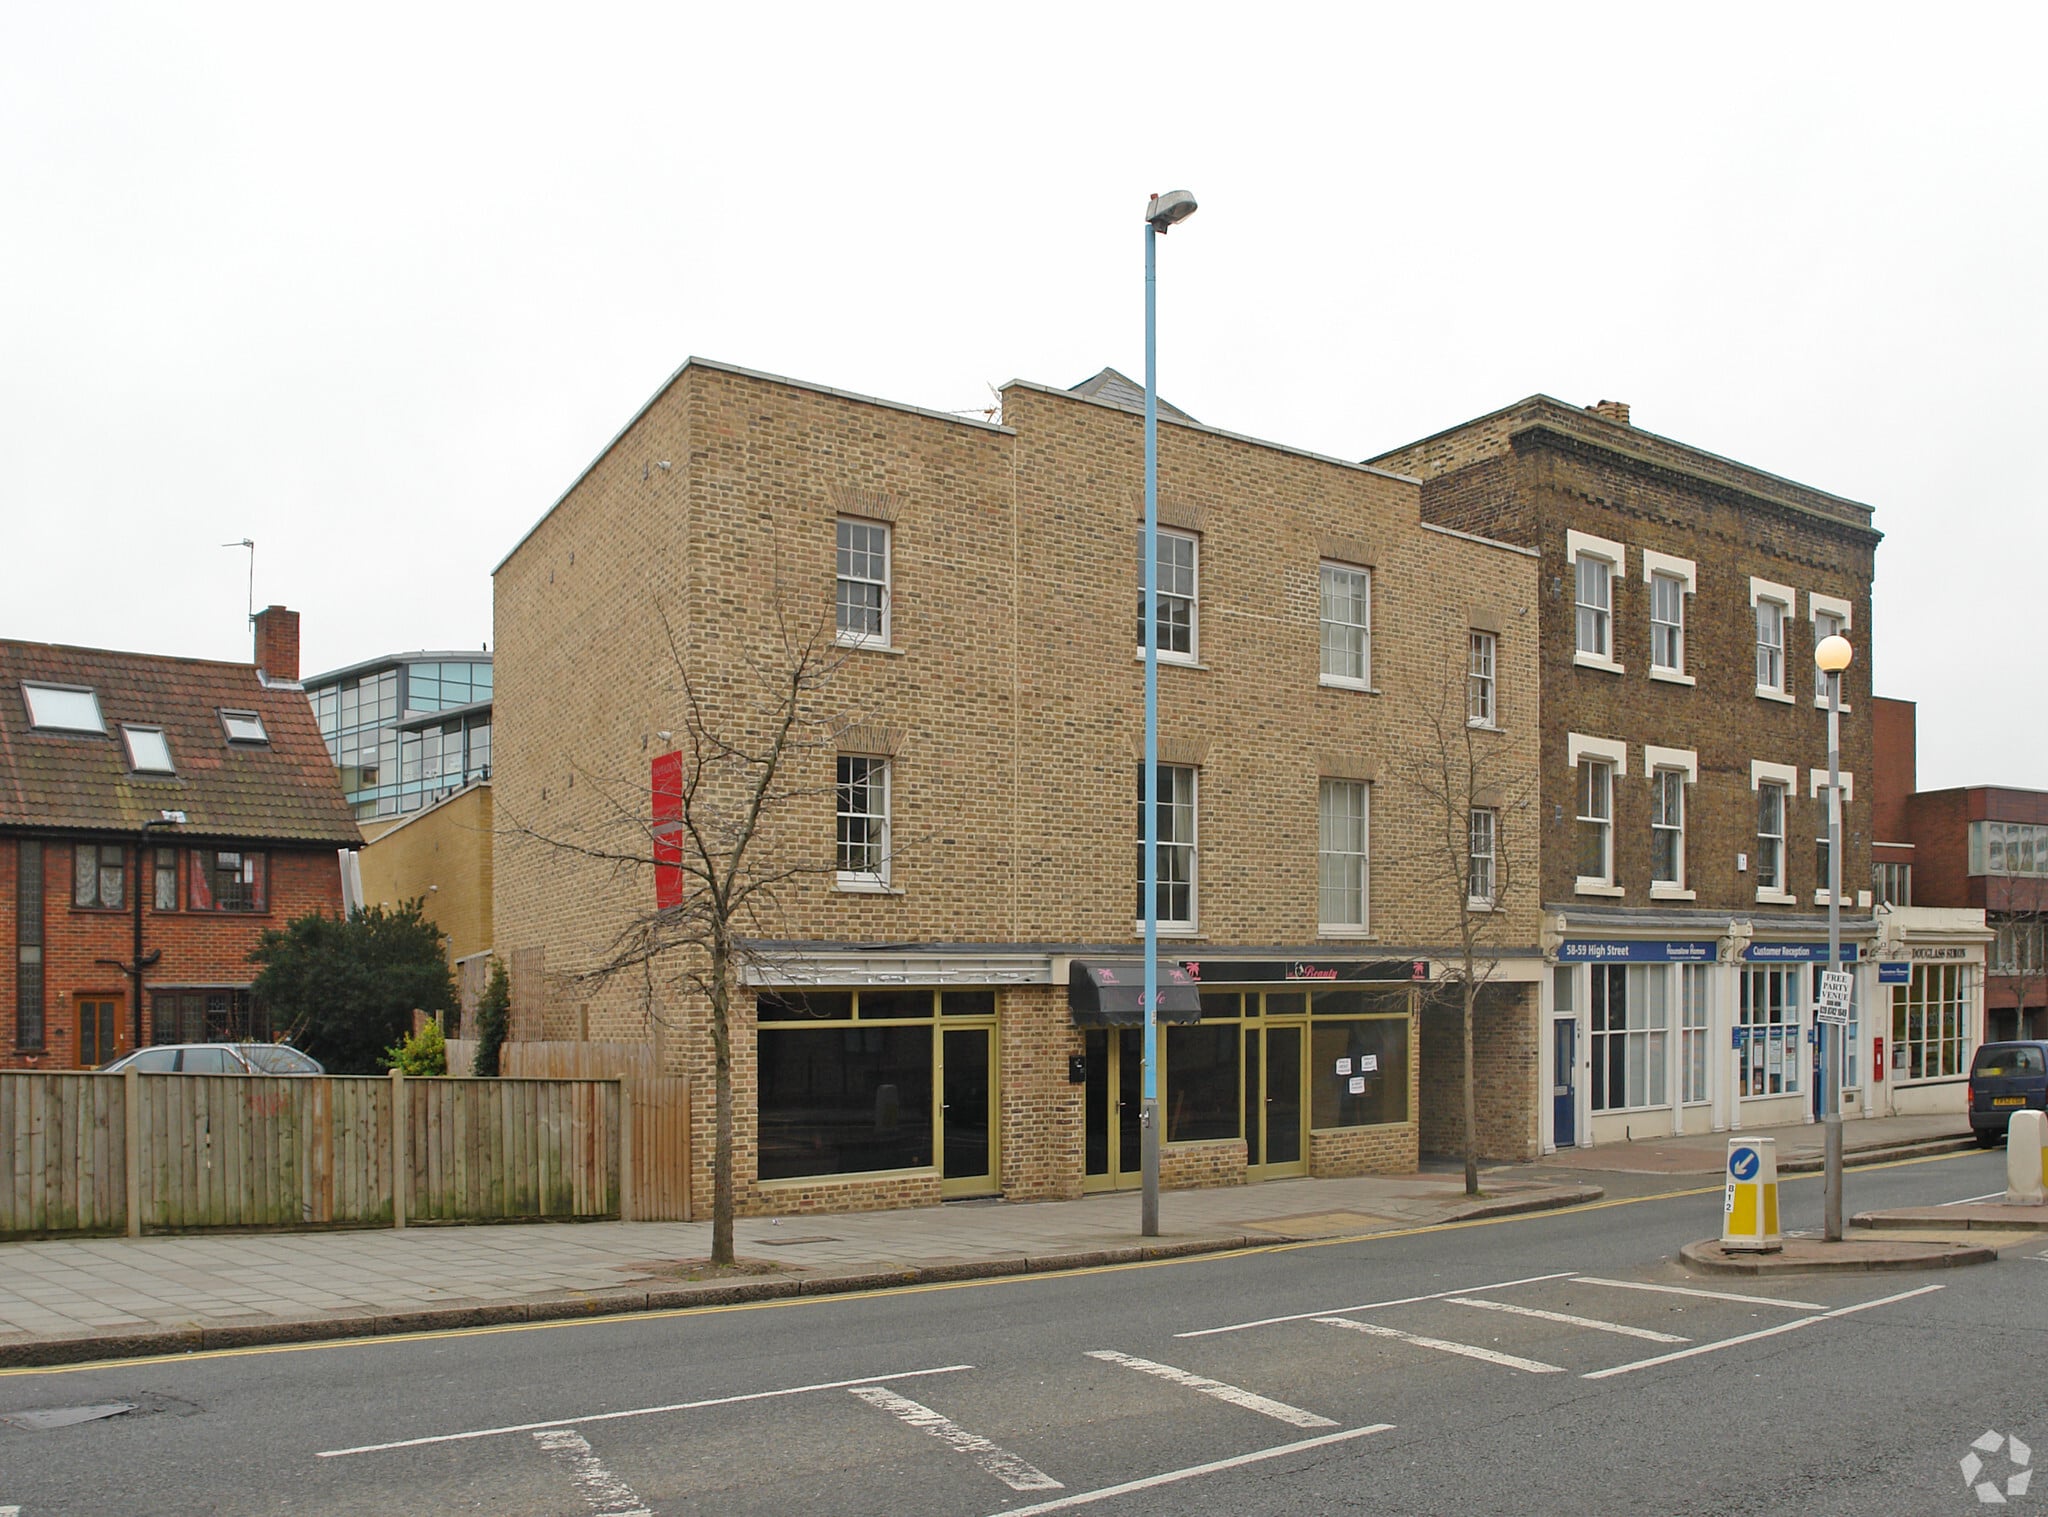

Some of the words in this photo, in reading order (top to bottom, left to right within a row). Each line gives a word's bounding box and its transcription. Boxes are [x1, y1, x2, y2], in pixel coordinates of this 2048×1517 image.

[1566, 944, 1587, 956] 58-59
[1588, 944, 1606, 958] High
[1607, 944, 1630, 956] Street
[1753, 946, 1781, 956] Customer
[1782, 946, 1810, 958] Reception
[1912, 948, 1945, 959] DOUGLASS
[1946, 948, 1966, 959] SIMON
[1826, 974, 1847, 983] FREE
[1823, 982, 1848, 992] PARTY
[1137, 990, 1166, 1006] Cfe
[1822, 991, 1848, 1000] VENUE
